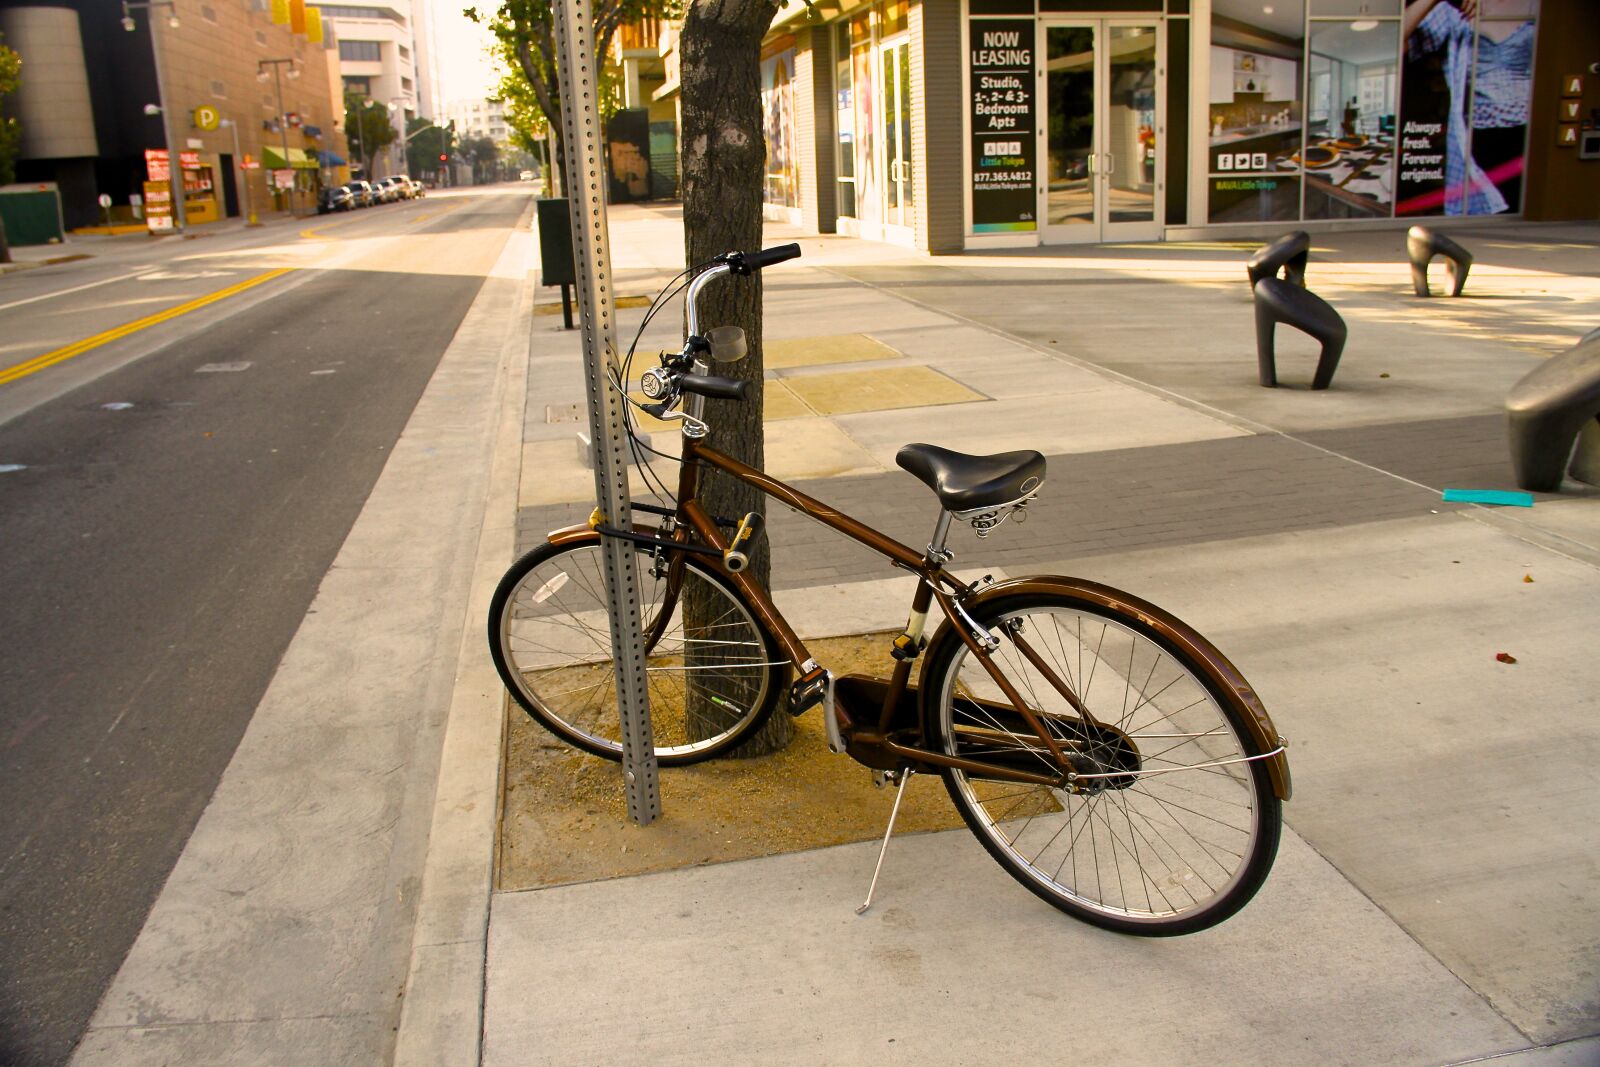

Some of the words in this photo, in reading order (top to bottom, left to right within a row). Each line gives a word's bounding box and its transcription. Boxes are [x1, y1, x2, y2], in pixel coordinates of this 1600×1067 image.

[983, 32, 1019, 47] NOW
[972, 50, 1031, 66] LEASING
[981, 76, 1023, 89] Studio,
[991, 91, 1004, 101] 2-
[1005, 90, 1014, 101] &
[1016, 91, 1029, 102] 3-
[975, 103, 1029, 115] Bedroom
[200, 109, 214, 126] P
[988, 116, 1015, 129] Apts
[1402, 121, 1442, 136] Always
[1402, 137, 1433, 149] fresh.
[980, 157, 1001, 166] Little
[1002, 157, 1026, 167] Tokyo
[1401, 152, 1443, 165] Forever
[974, 172, 1032, 182] 877.365.4812
[1401, 168, 1444, 183] original.
